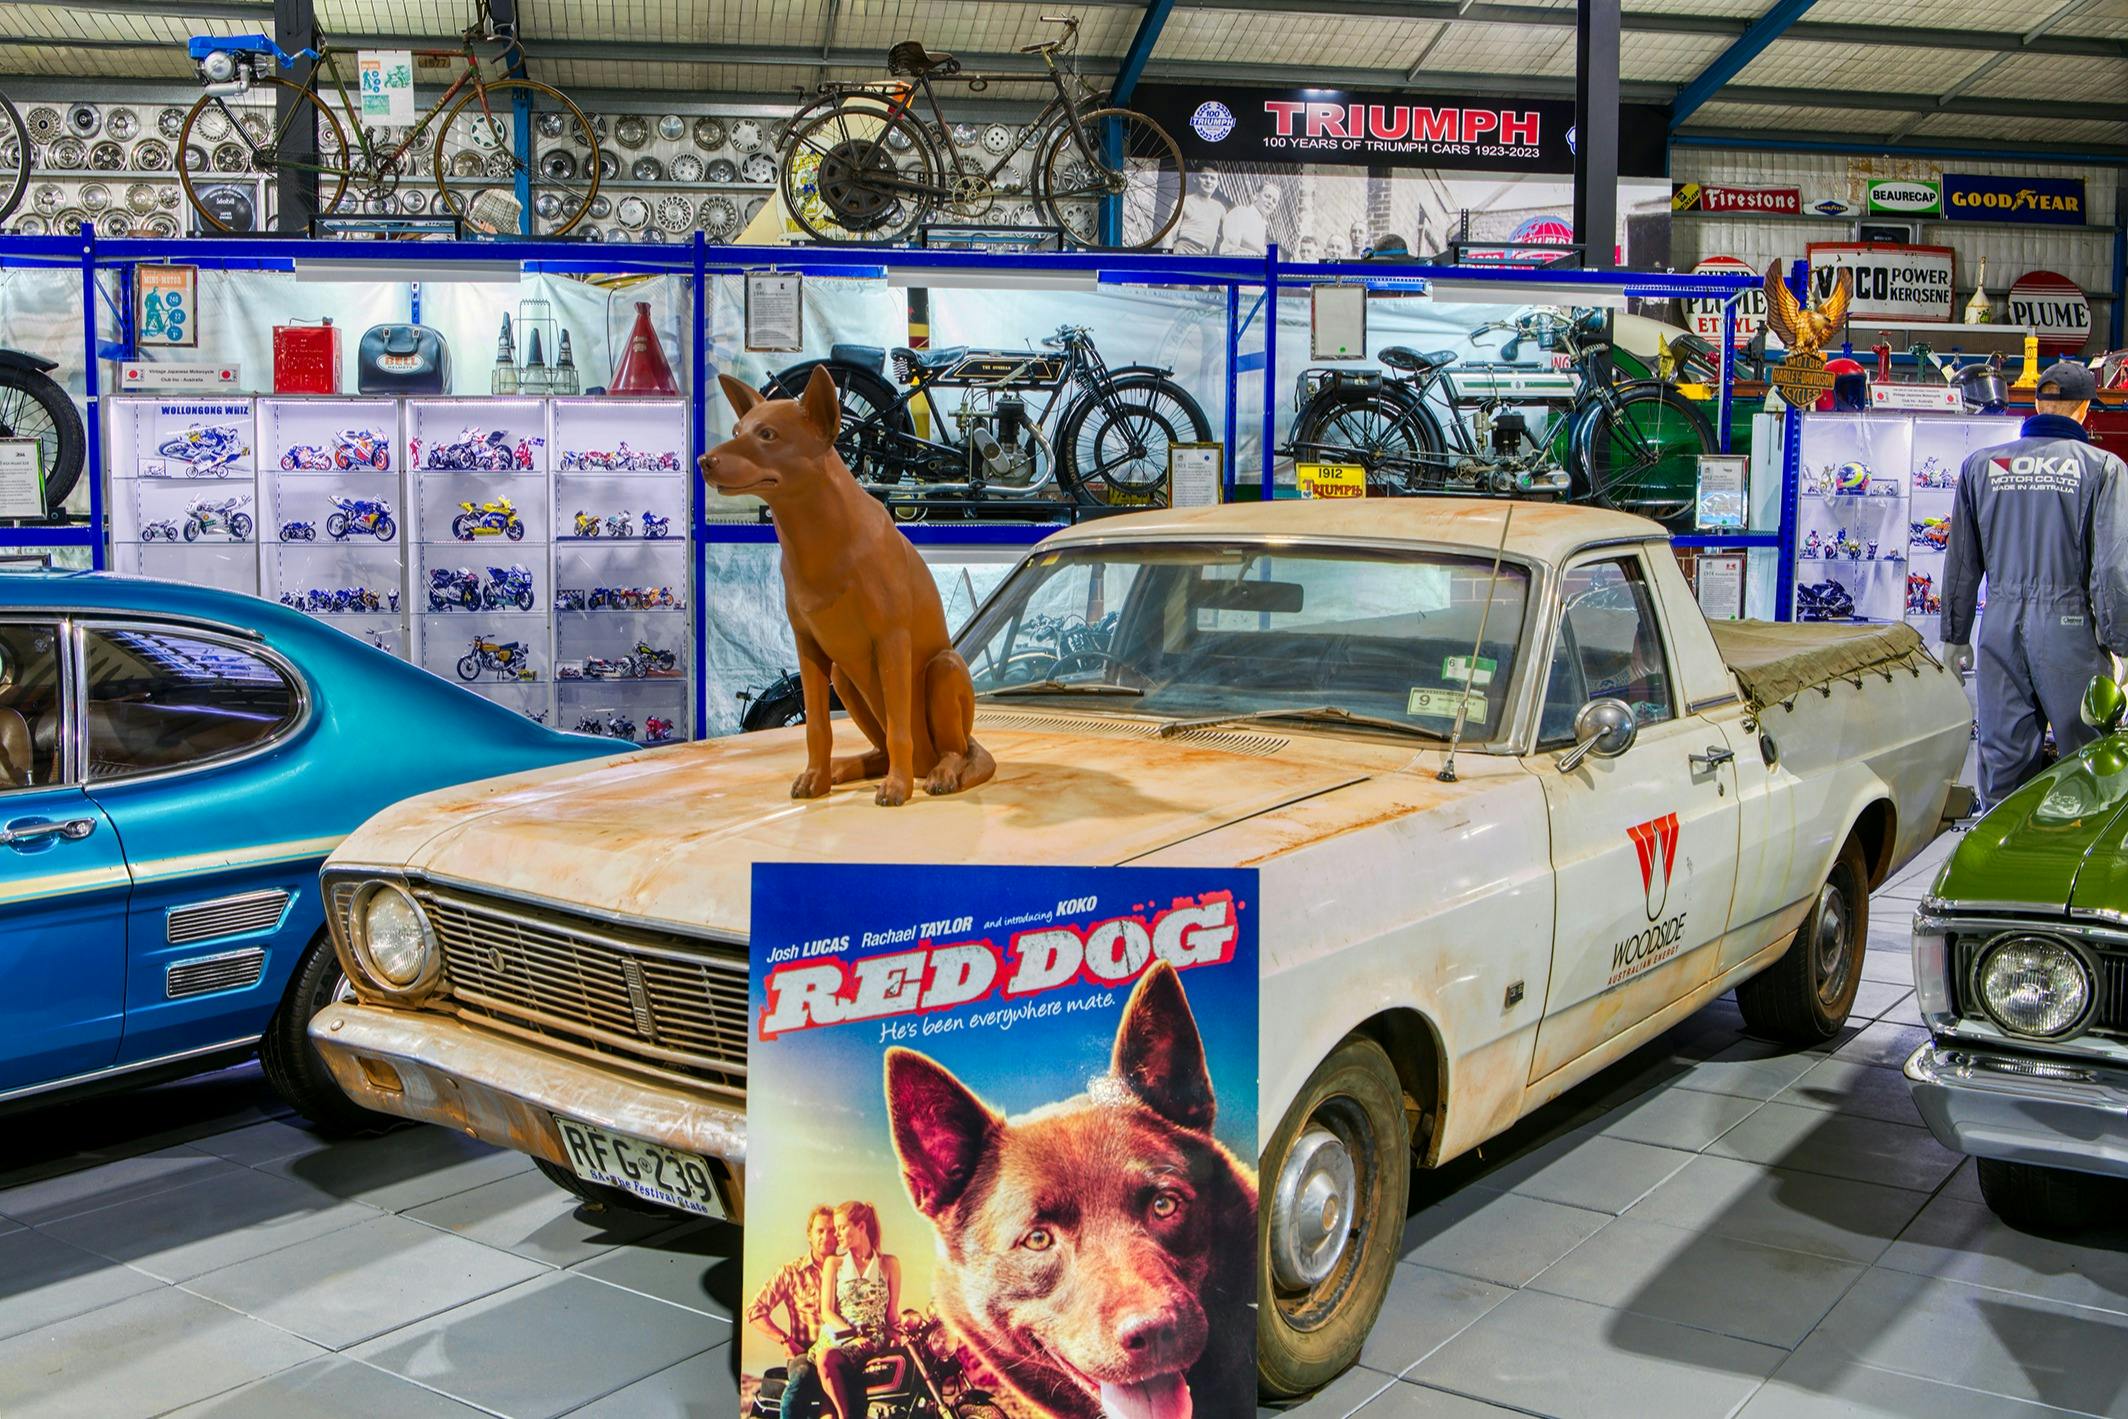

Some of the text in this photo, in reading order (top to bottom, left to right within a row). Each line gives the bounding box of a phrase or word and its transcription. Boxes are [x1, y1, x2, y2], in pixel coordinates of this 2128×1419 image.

[1193, 117, 1234, 127] TRIUMPH
[1206, 110, 1220, 118] 100
[1264, 101, 1541, 146] TRIUMPH
[1263, 137, 1540, 158] 100 YEARS OF TRIUMPH CARS 1923-2023
[1705, 188, 1796, 210] Firestone
[1872, 190, 1936, 203] BEAURECAP
[1952, 191, 2080, 212] GOOD YEAR
[1890, 267, 1949, 285] POWER
[1889, 287, 1950, 304] KEROSENE
[2012, 301, 2089, 328] PLUME
[1697, 318, 1756, 333] ETYL
[385, 355, 417, 366] BELL
[1787, 355, 1822, 369] MOTOR
[1773, 367, 1834, 388] HARLEY-DAVIDSON
[1785, 386, 1820, 404] CYCLES
[161, 405, 249, 415] WOLLONGONG WHIZ
[1318, 467, 1343, 479] 1912
[2011, 456, 2081, 479] OKA
[1303, 479, 1363, 498] TRIUMPH
[1991, 475, 2034, 485] MOTOR
[1992, 484, 2016, 492] MADE
[2028, 484, 2075, 494] AUSTRALIA
[1448, 658, 1456, 668] 6
[1419, 694, 1431, 706] 9
[766, 895, 1098, 964] Josh LUCAS Rachael TAYLOR and introducing KOKO
[1611, 912, 1687, 972] WOODSIDE
[763, 901, 1236, 1034] RED DOG
[1607, 944, 1680, 985] AUSTRALIAN ENERGY
[879, 991, 1116, 1044] He's been everywhere mate.
[563, 1125, 712, 1202] RFG 239
[633, 1180, 676, 1204] Festival
[677, 1196, 709, 1214] State
